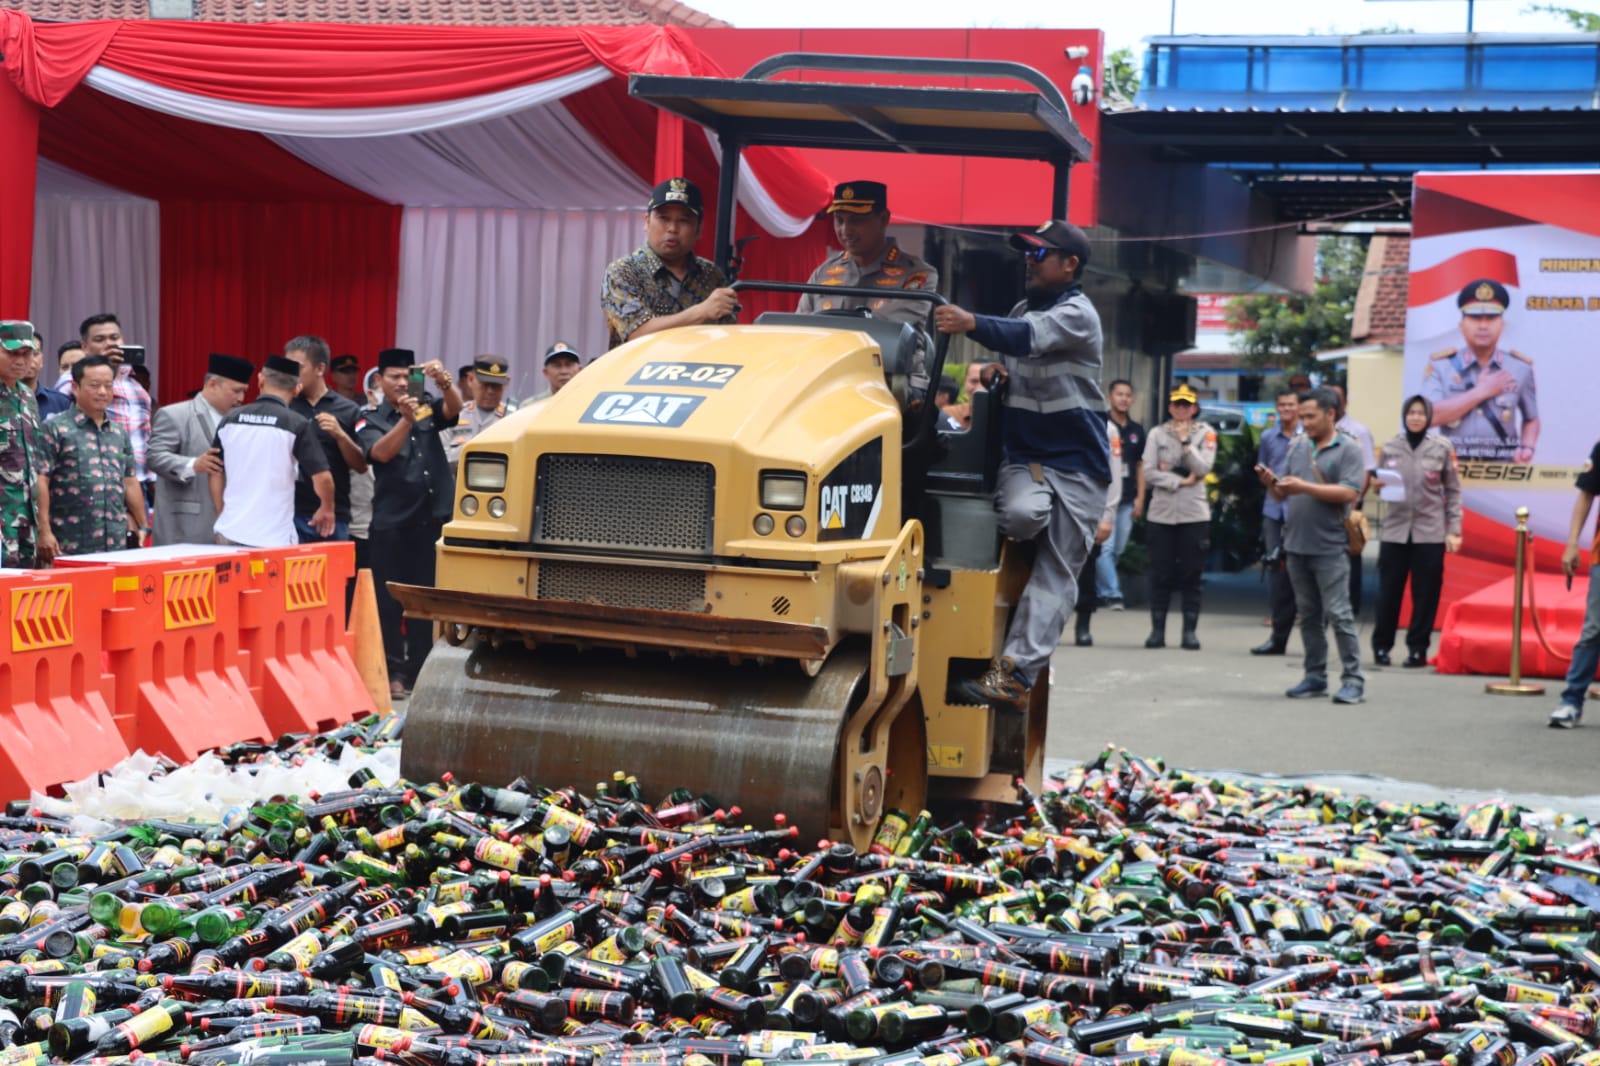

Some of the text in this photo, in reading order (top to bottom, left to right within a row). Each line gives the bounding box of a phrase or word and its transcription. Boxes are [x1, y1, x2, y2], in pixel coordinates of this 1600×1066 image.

[1527, 296, 1585, 310] SELAMA
[638, 364, 736, 384] VR-02
[592, 393, 693, 424] CAT
[1457, 464, 1534, 481] RESISI
[821, 485, 848, 529] CAT
